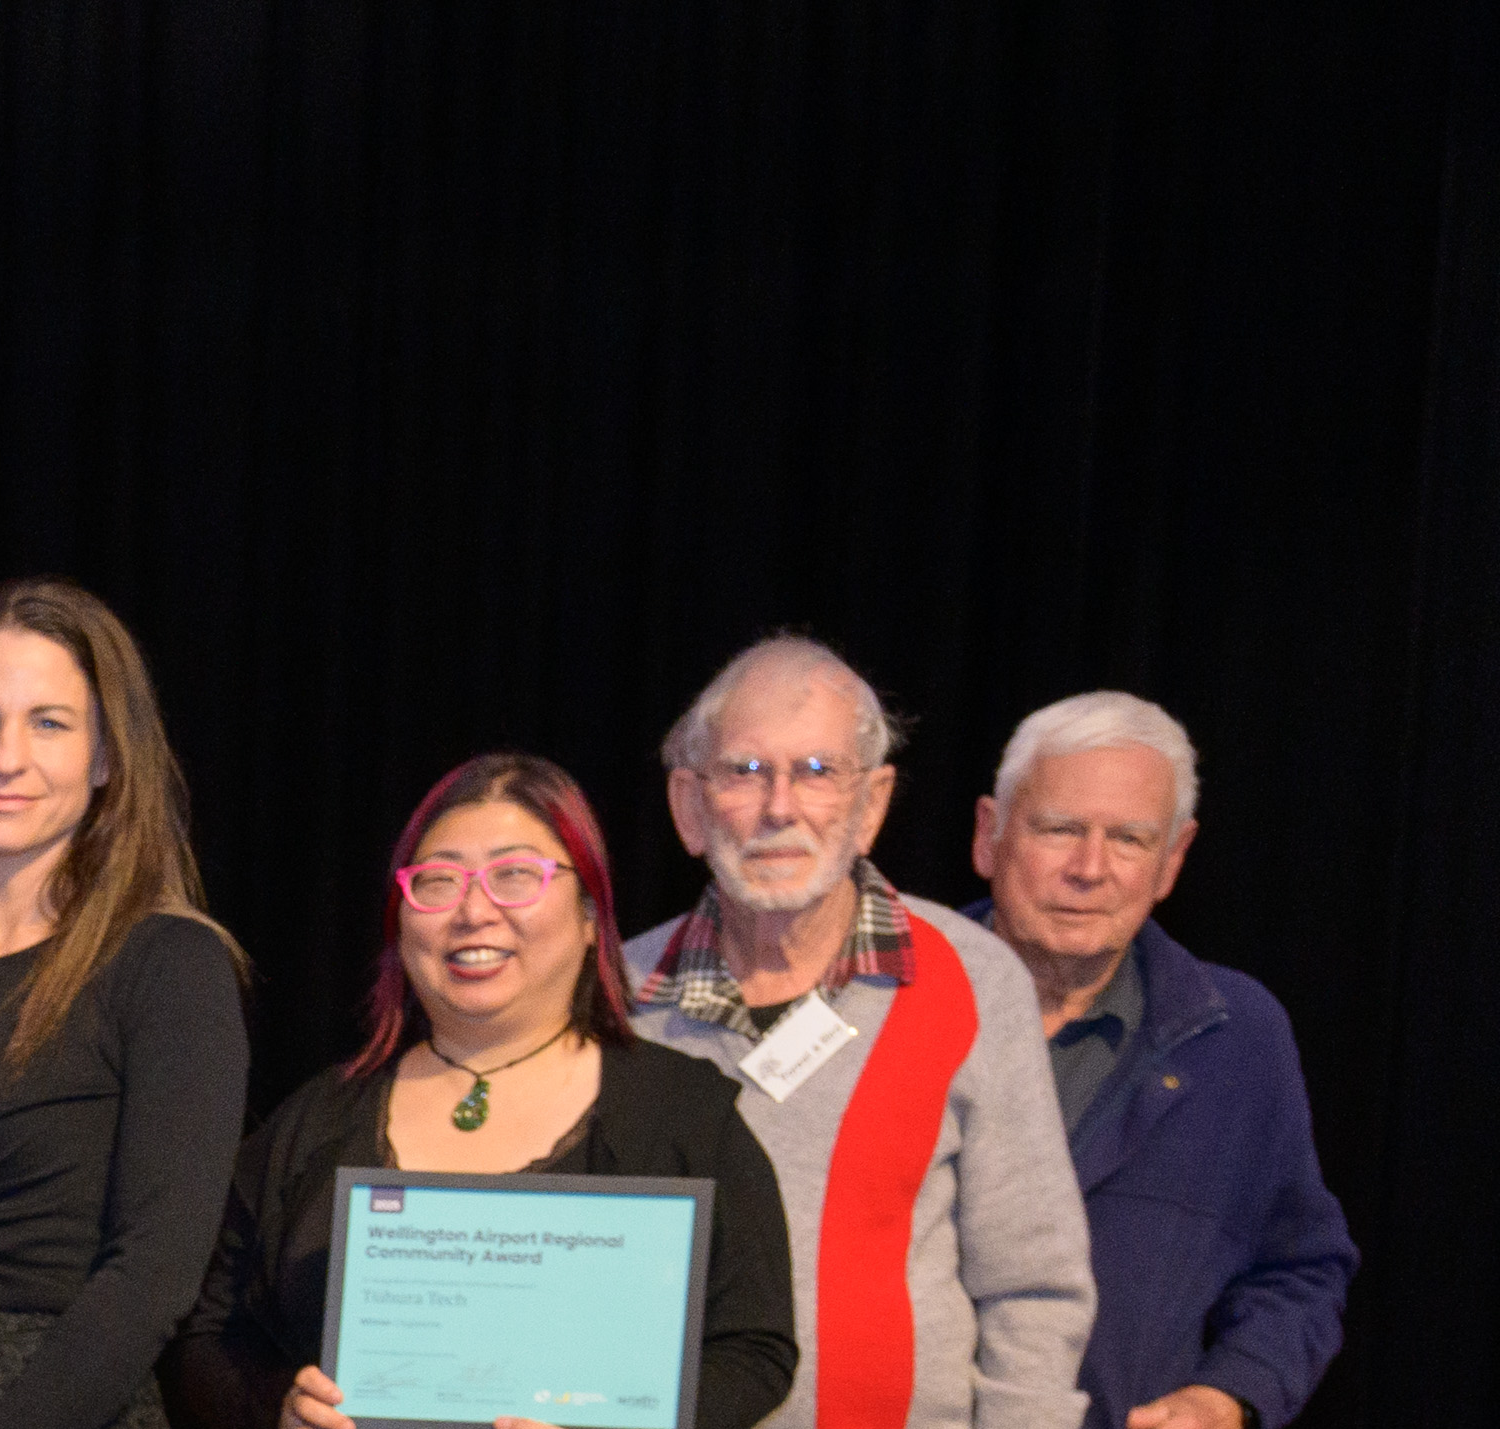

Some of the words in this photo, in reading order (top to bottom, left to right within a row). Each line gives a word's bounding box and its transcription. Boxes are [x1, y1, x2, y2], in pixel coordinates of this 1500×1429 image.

[368, 1226, 468, 1244] Wellington
[473, 1229, 536, 1248] Airport
[542, 1232, 625, 1250] Regional
[365, 1245, 476, 1265] Community
[482, 1250, 543, 1265] Award
